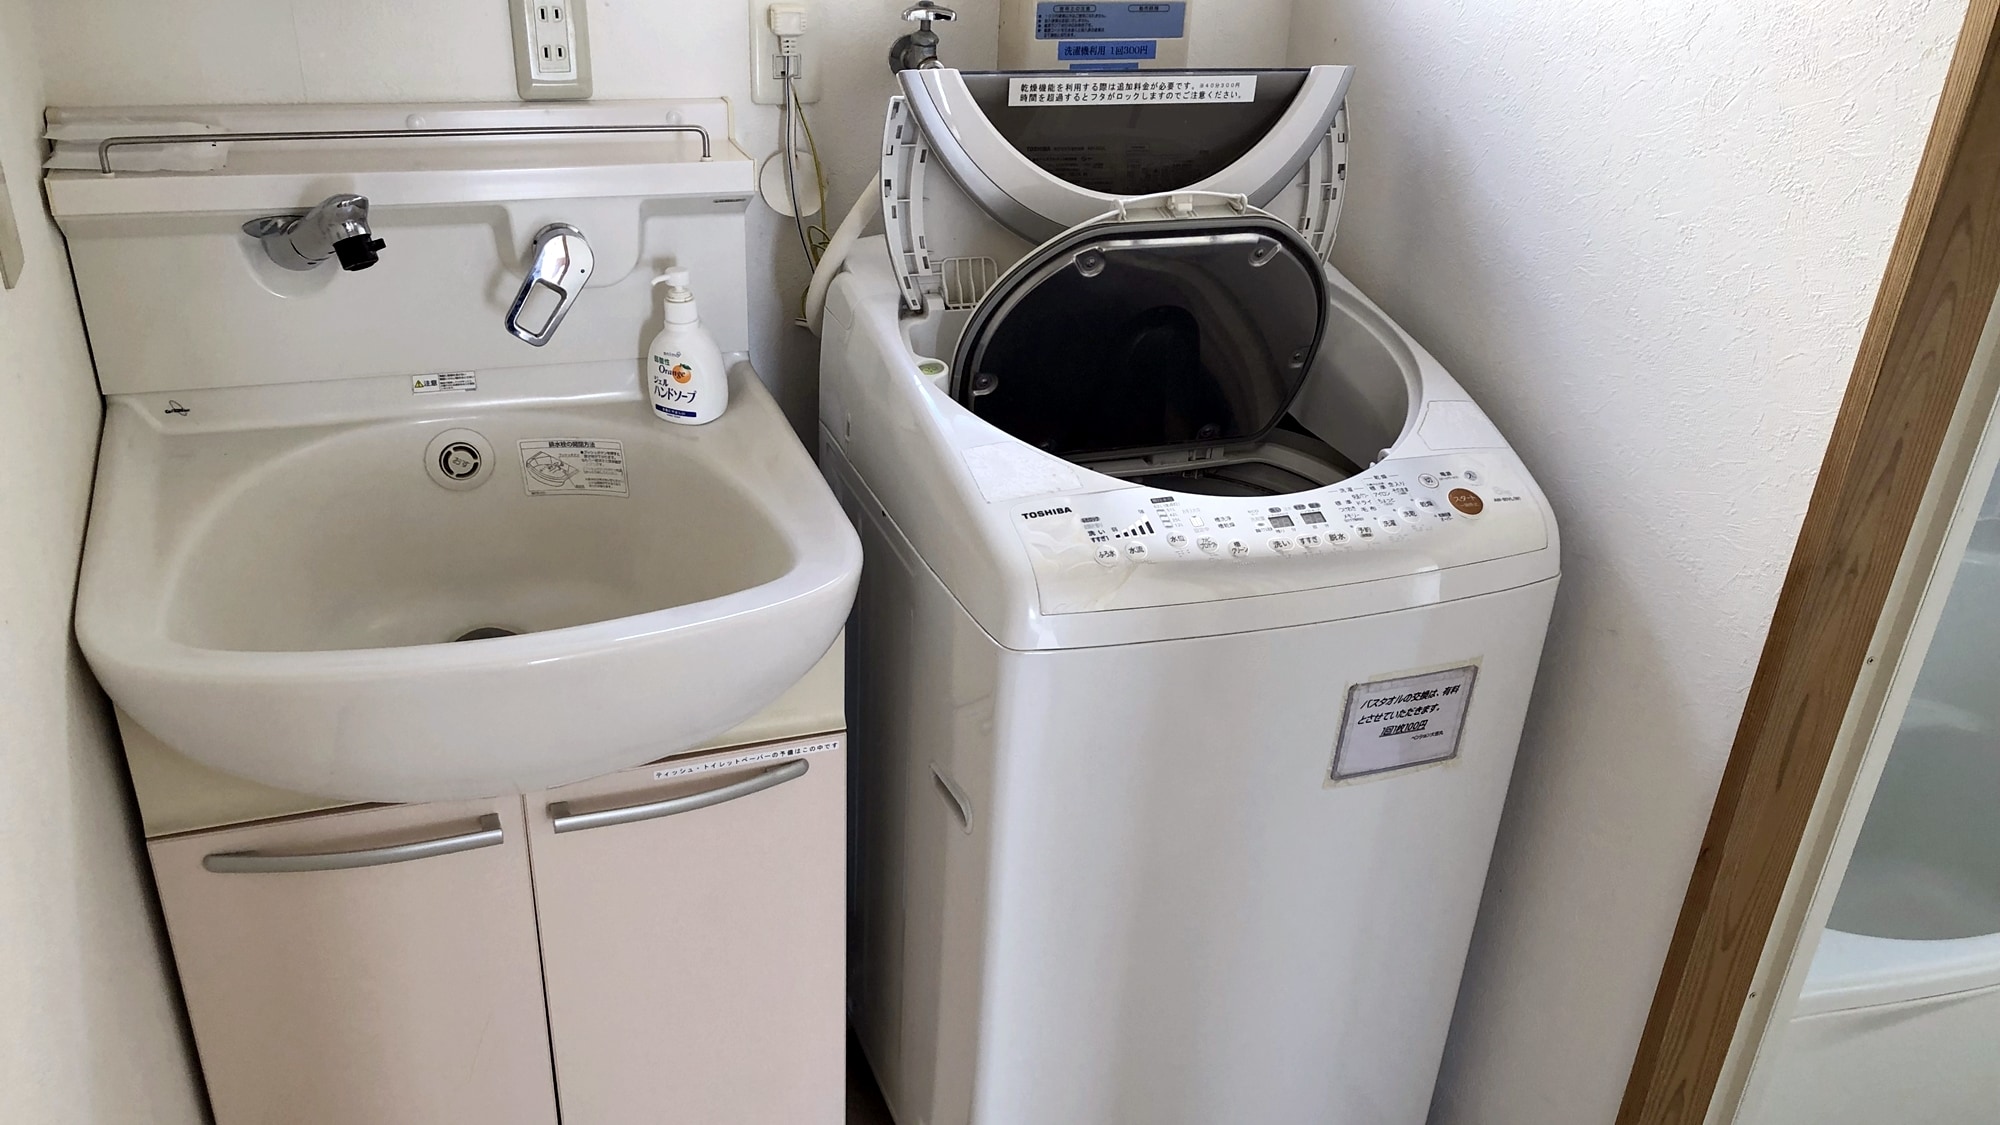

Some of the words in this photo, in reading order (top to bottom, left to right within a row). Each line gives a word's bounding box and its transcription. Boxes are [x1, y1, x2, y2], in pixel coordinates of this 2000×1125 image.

[1064, 45, 1106, 56] 洗濯機利用
[1110, 44, 1149, 55] 1回300円
[1020, 90, 1241, 102] 時間を超過するとフタがロックしますのでご注意ください。
[658, 365, 686, 379] Orange
[653, 375, 668, 387] ジェル
[653, 385, 697, 404] ハンドソープ
[1021, 506, 1073, 520] TOSHIBA
[1357, 703, 1440, 724] とさせていただきます。
[655, 743, 838, 778] ティッシュ・トイレットペーパーの予備はこの中です
